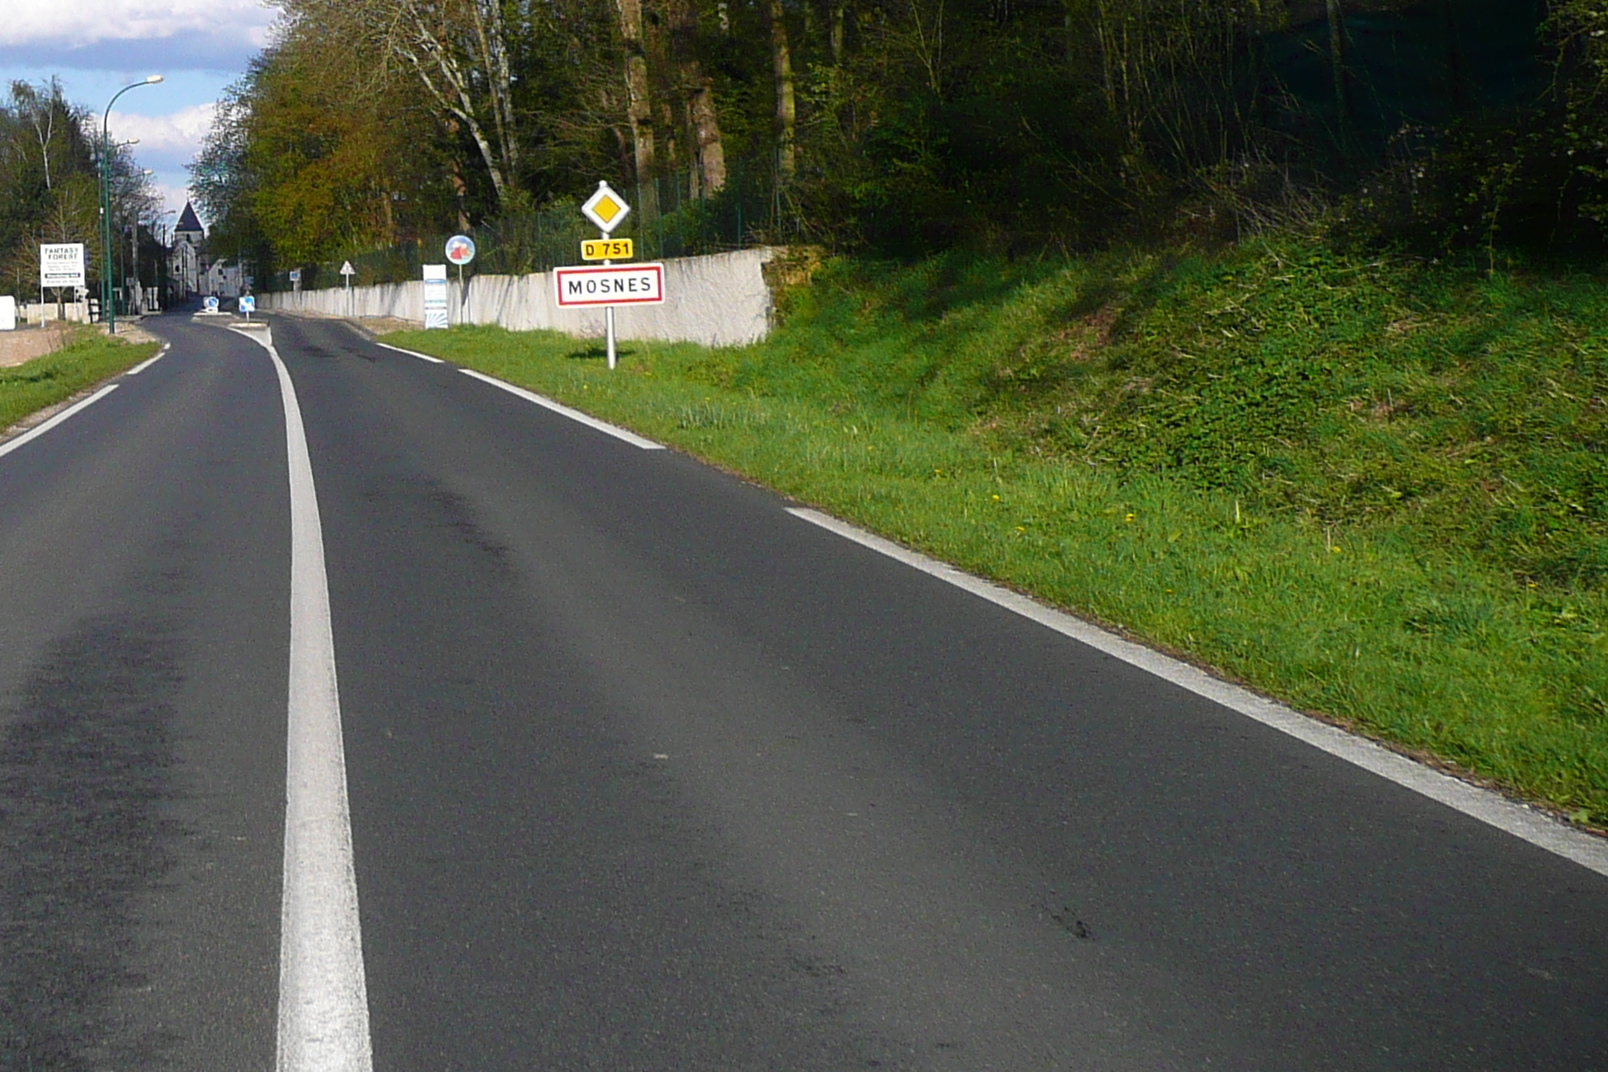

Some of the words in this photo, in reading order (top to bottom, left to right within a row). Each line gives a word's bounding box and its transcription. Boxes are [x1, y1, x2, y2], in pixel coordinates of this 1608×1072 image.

[585, 244, 594, 256] D
[602, 242, 629, 255] 751
[568, 277, 651, 295] MOSNES
